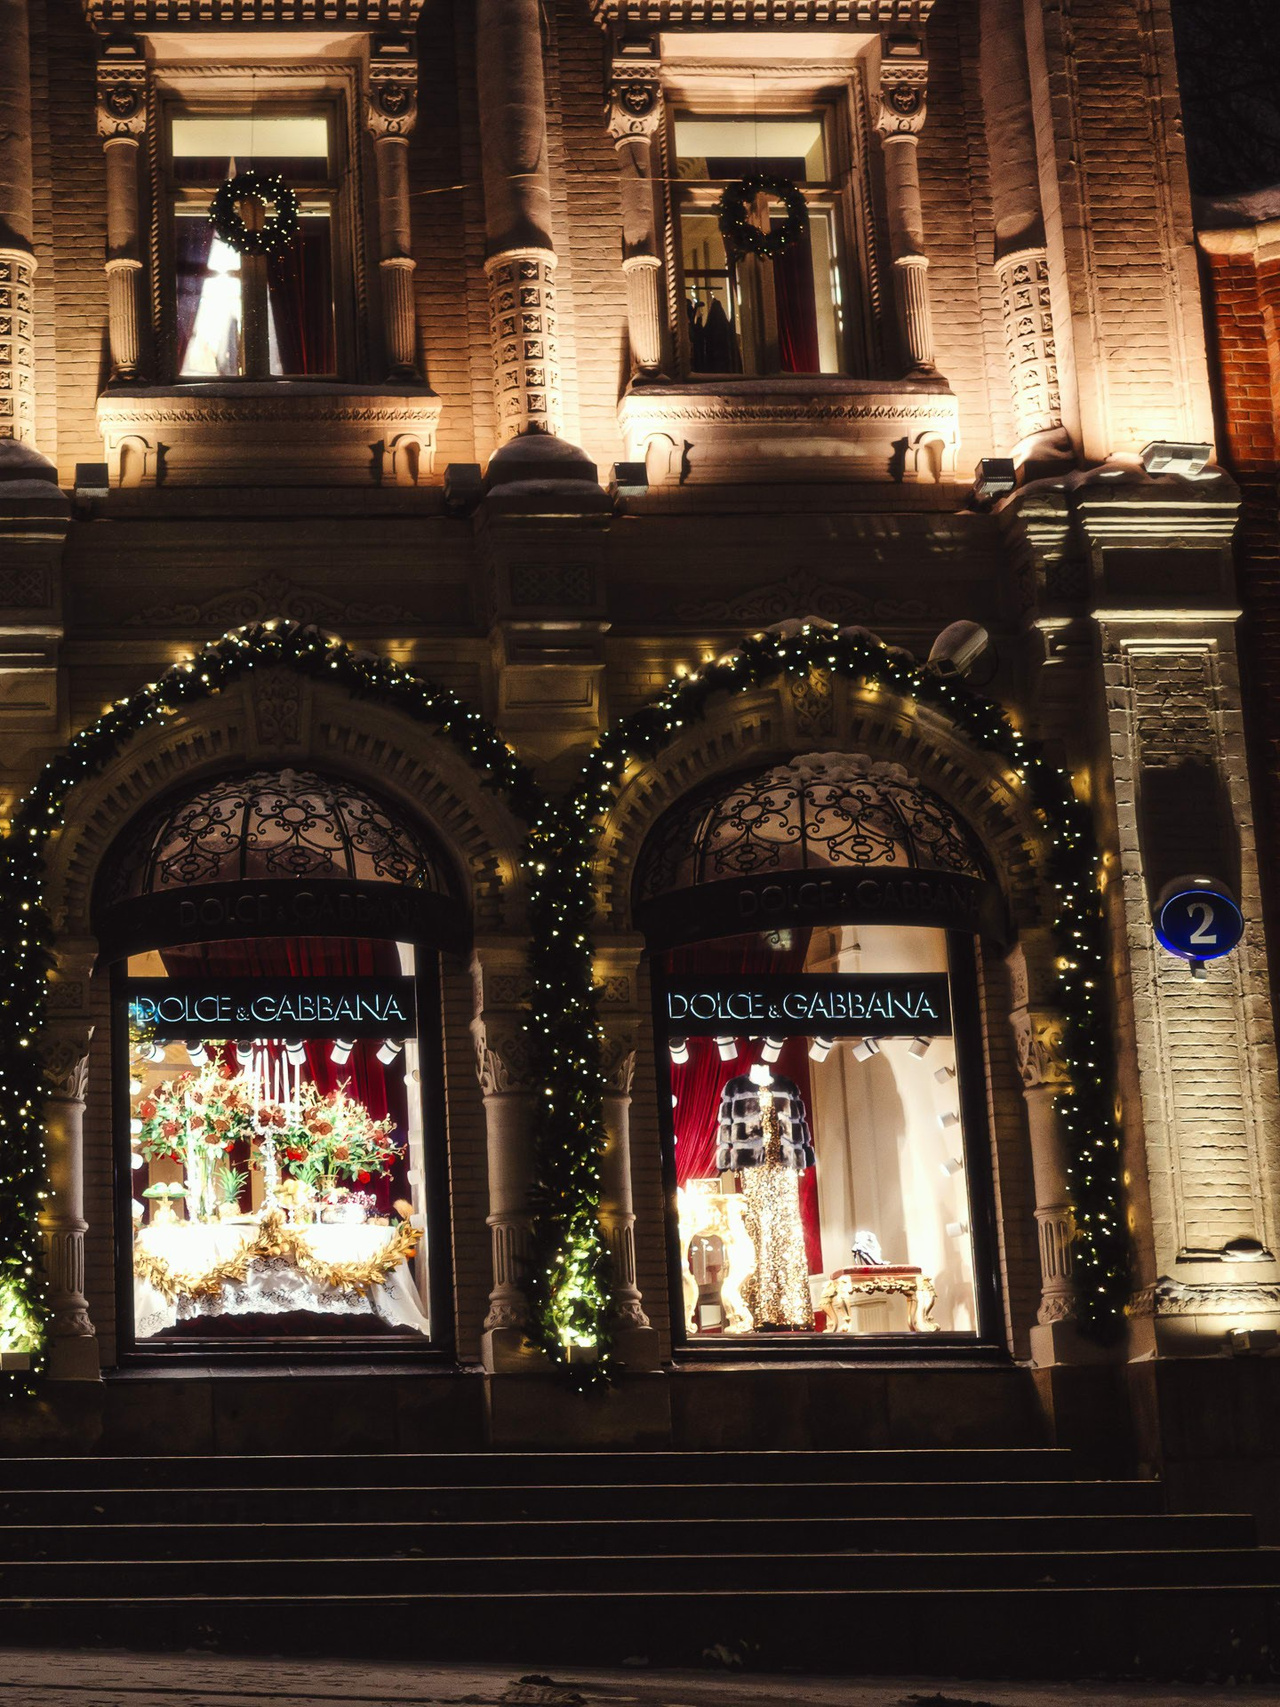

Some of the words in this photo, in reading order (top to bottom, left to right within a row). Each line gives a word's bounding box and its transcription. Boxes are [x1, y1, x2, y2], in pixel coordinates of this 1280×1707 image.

[180, 894, 270, 926] DOLCE
[738, 881, 838, 917] DOLCE
[1186, 902, 1217, 944] 2
[136, 995, 231, 1022] DOLCE
[251, 994, 406, 1022] GABBANA
[667, 991, 764, 1020] DOLCE
[783, 991, 938, 1020] GABBANA
